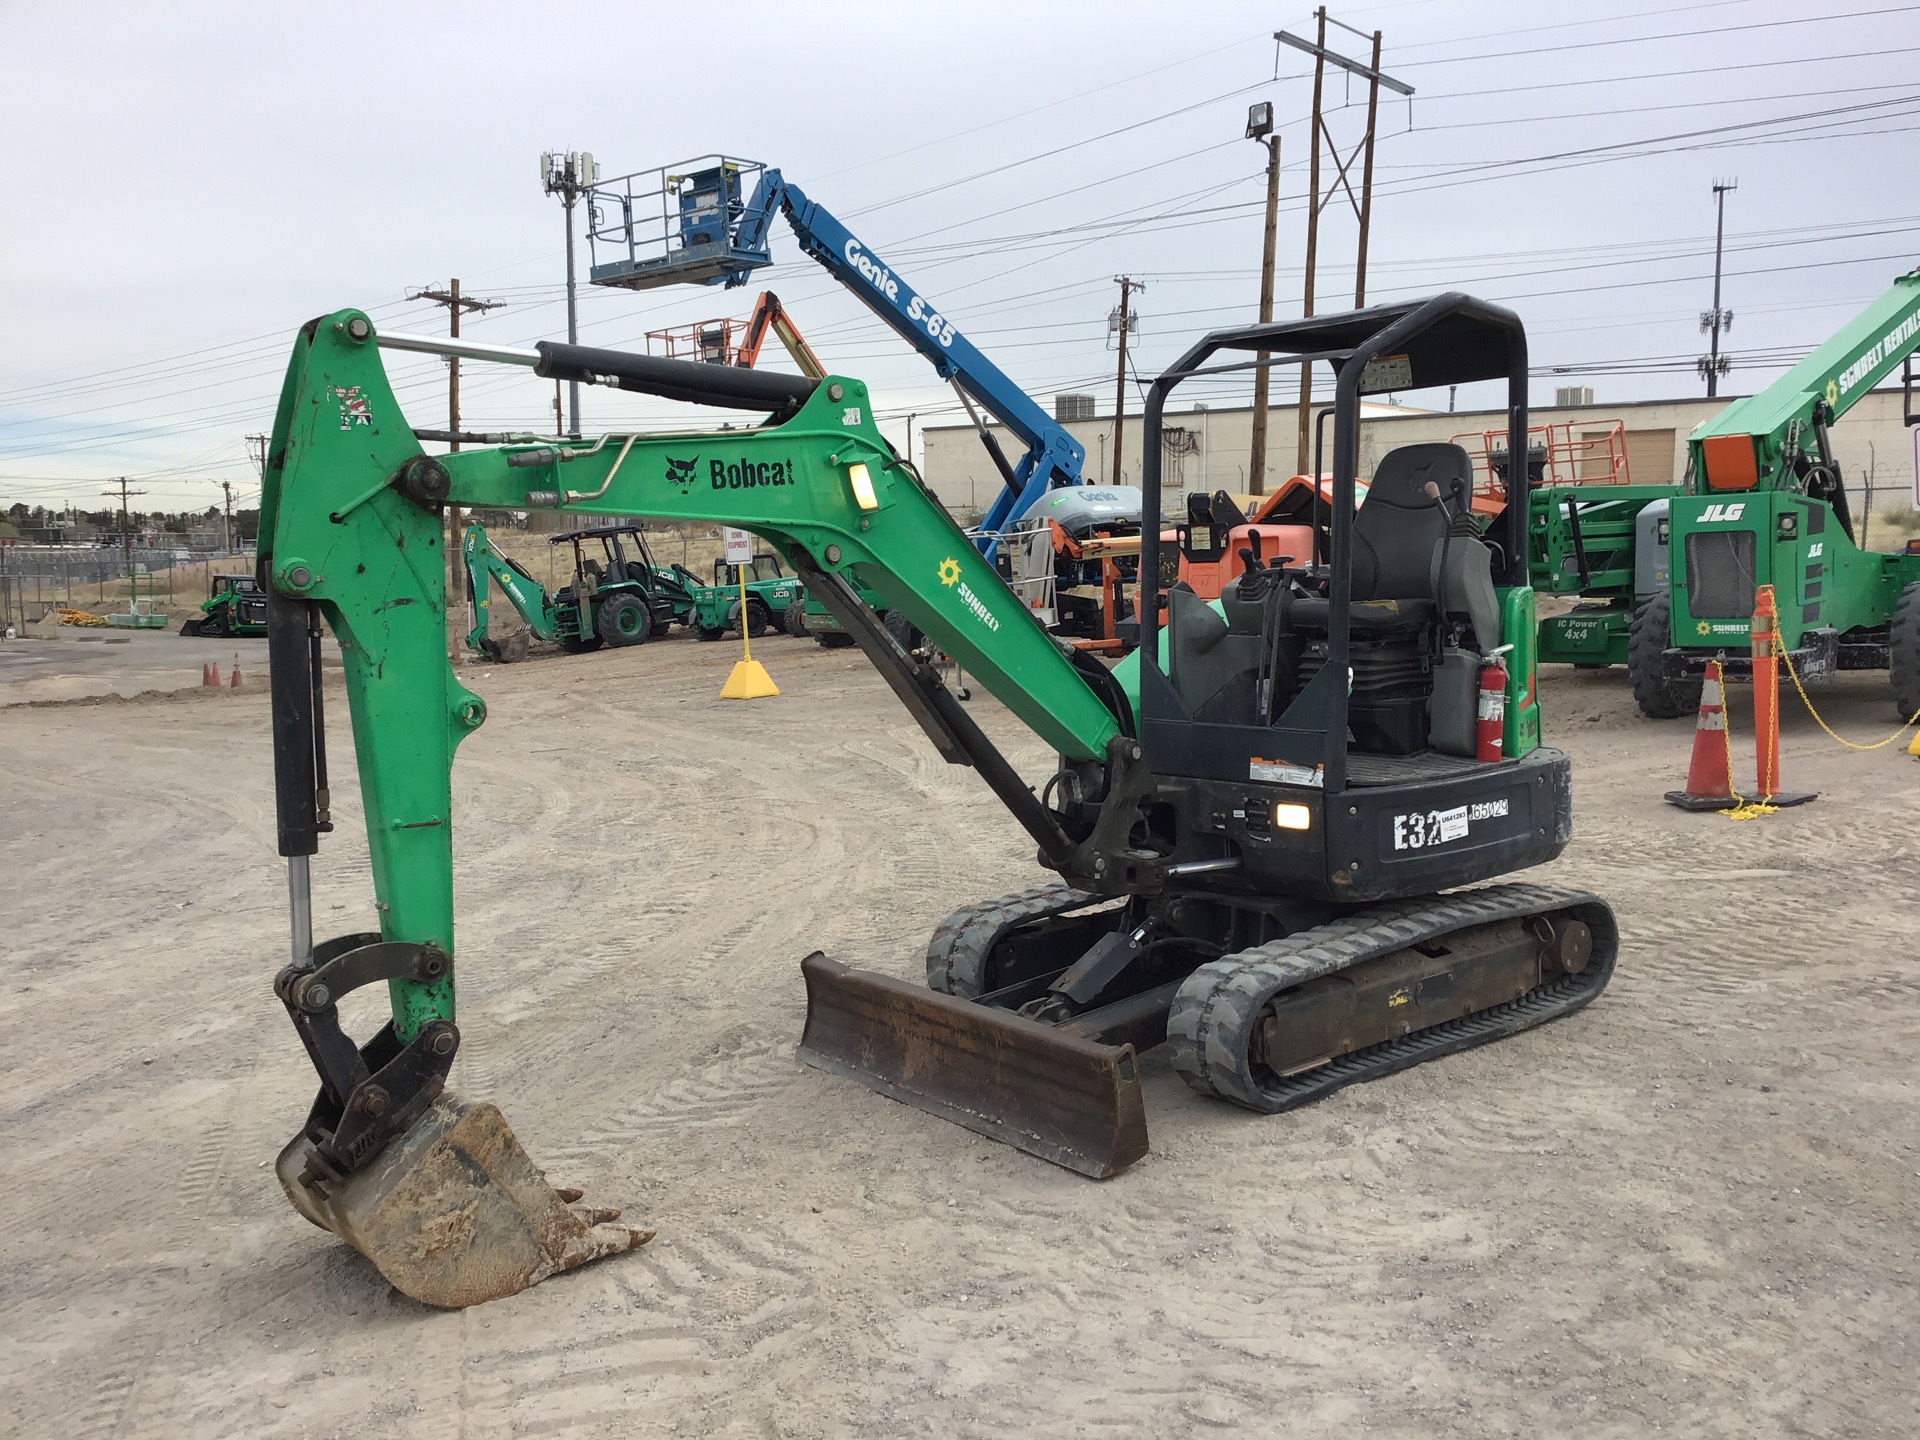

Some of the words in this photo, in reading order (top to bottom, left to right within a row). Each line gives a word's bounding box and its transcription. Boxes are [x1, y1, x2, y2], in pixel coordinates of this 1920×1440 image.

[844, 239, 899, 302] Genie
[907, 296, 957, 347] S-65
[1839, 341, 1883, 395] SUNBELT
[709, 457, 795, 490] Bobcat
[1696, 503, 1746, 523] JLG
[1808, 542, 1824, 558] JLG
[657, 570, 675, 581] JCB
[772, 590, 790, 599] JCB
[957, 582, 1000, 632] SUNBELT
[1557, 620, 1567, 628] IC
[1569, 620, 1598, 628] Power
[1712, 624, 1750, 632] SUNBELT
[1564, 629, 1588, 640] 4x4
[1394, 810, 1441, 850] E32
